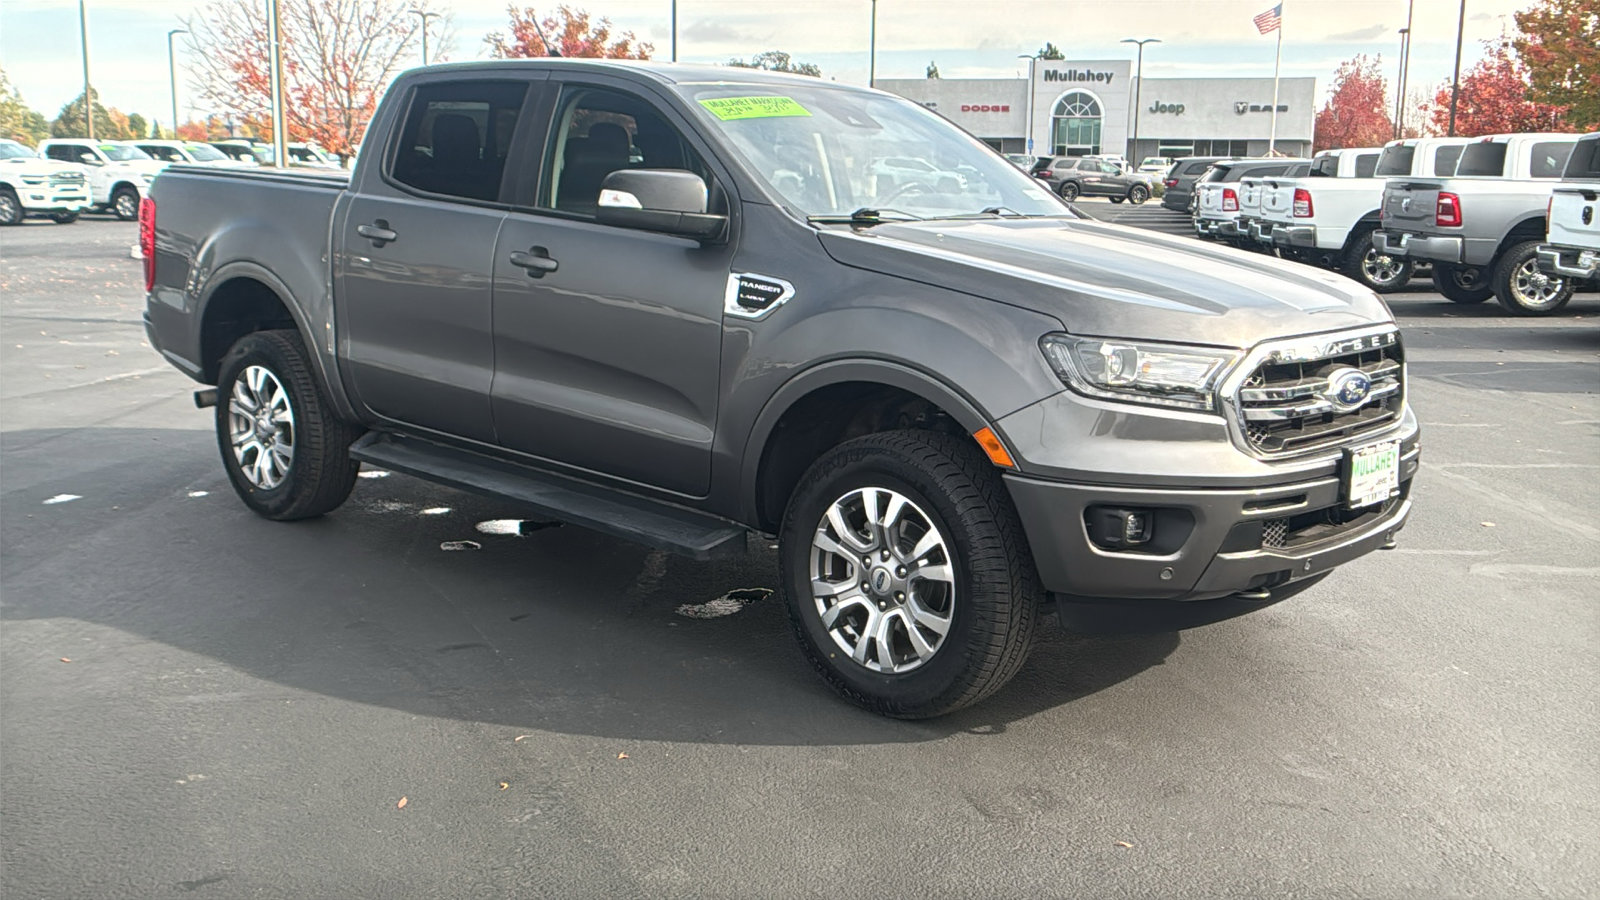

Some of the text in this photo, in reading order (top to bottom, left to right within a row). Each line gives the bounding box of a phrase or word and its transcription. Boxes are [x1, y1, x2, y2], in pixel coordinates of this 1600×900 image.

[1044, 69, 1114, 84] Mullahey
[961, 105, 1010, 113] DODGE
[1149, 100, 1185, 115] Jeep
[1250, 105, 1288, 113] RAM
[740, 281, 781, 294] RANGER
[1352, 449, 1397, 477] MULLAHEY
